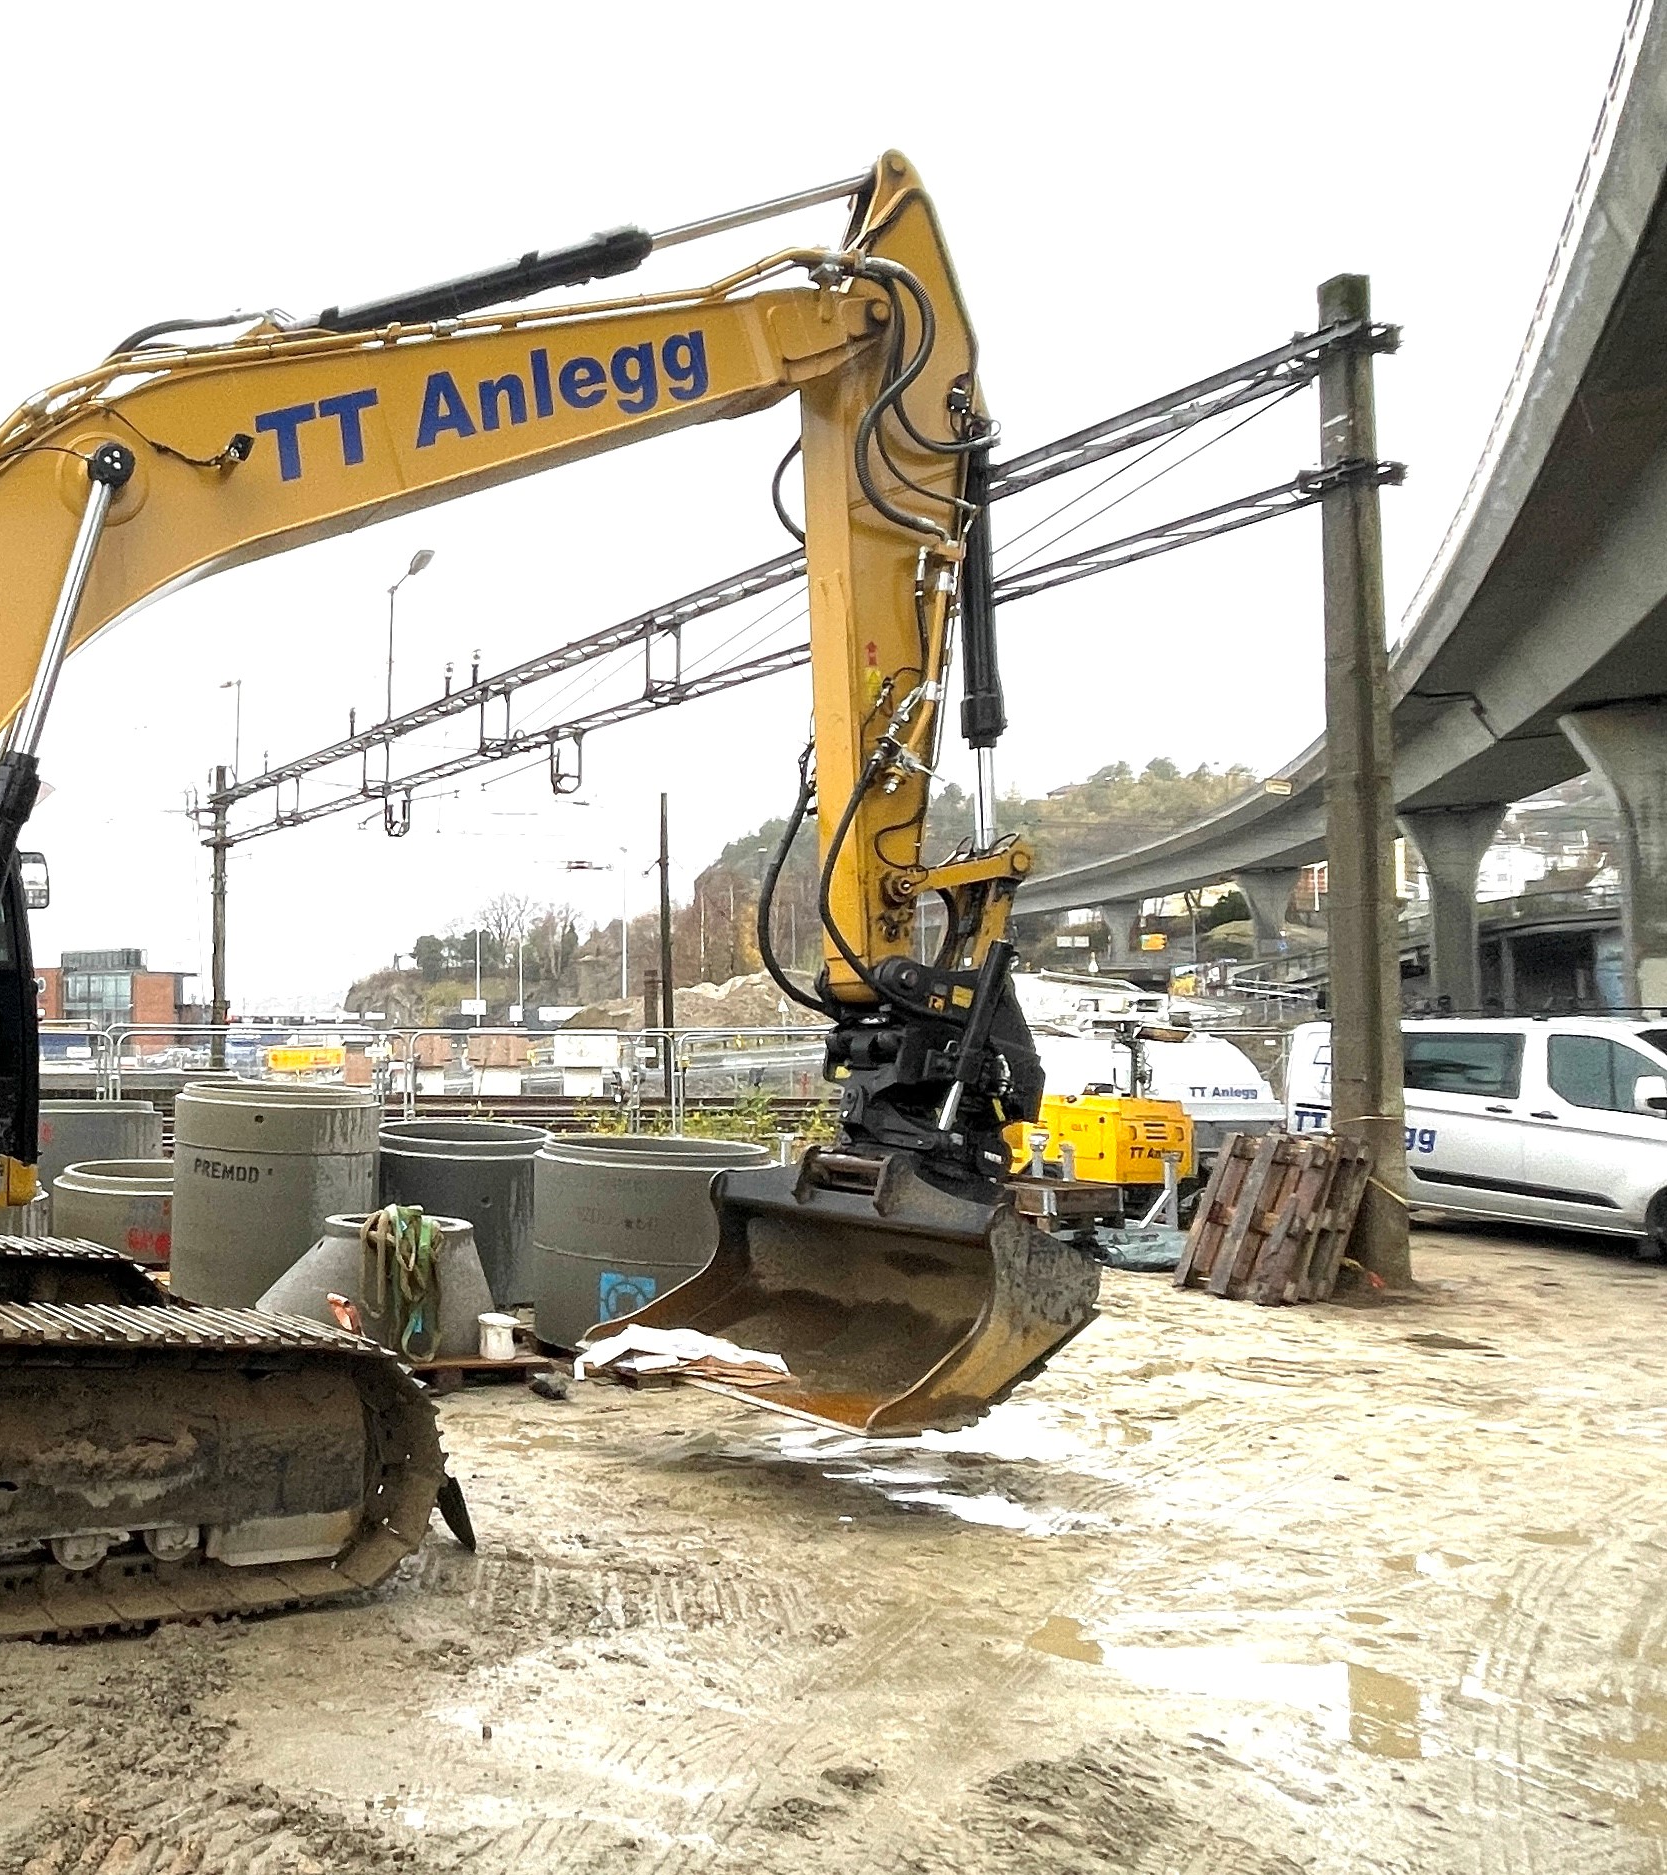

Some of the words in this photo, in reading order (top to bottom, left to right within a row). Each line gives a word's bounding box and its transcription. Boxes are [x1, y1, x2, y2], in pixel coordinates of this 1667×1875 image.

[255, 388, 378, 481] TT
[416, 330, 709, 448] Anlegg
[1189, 1086, 1207, 1098] TT
[1212, 1086, 1258, 1100] Anlegg
[1129, 1146, 1145, 1159] TT
[194, 1157, 260, 1184] PREMOD
